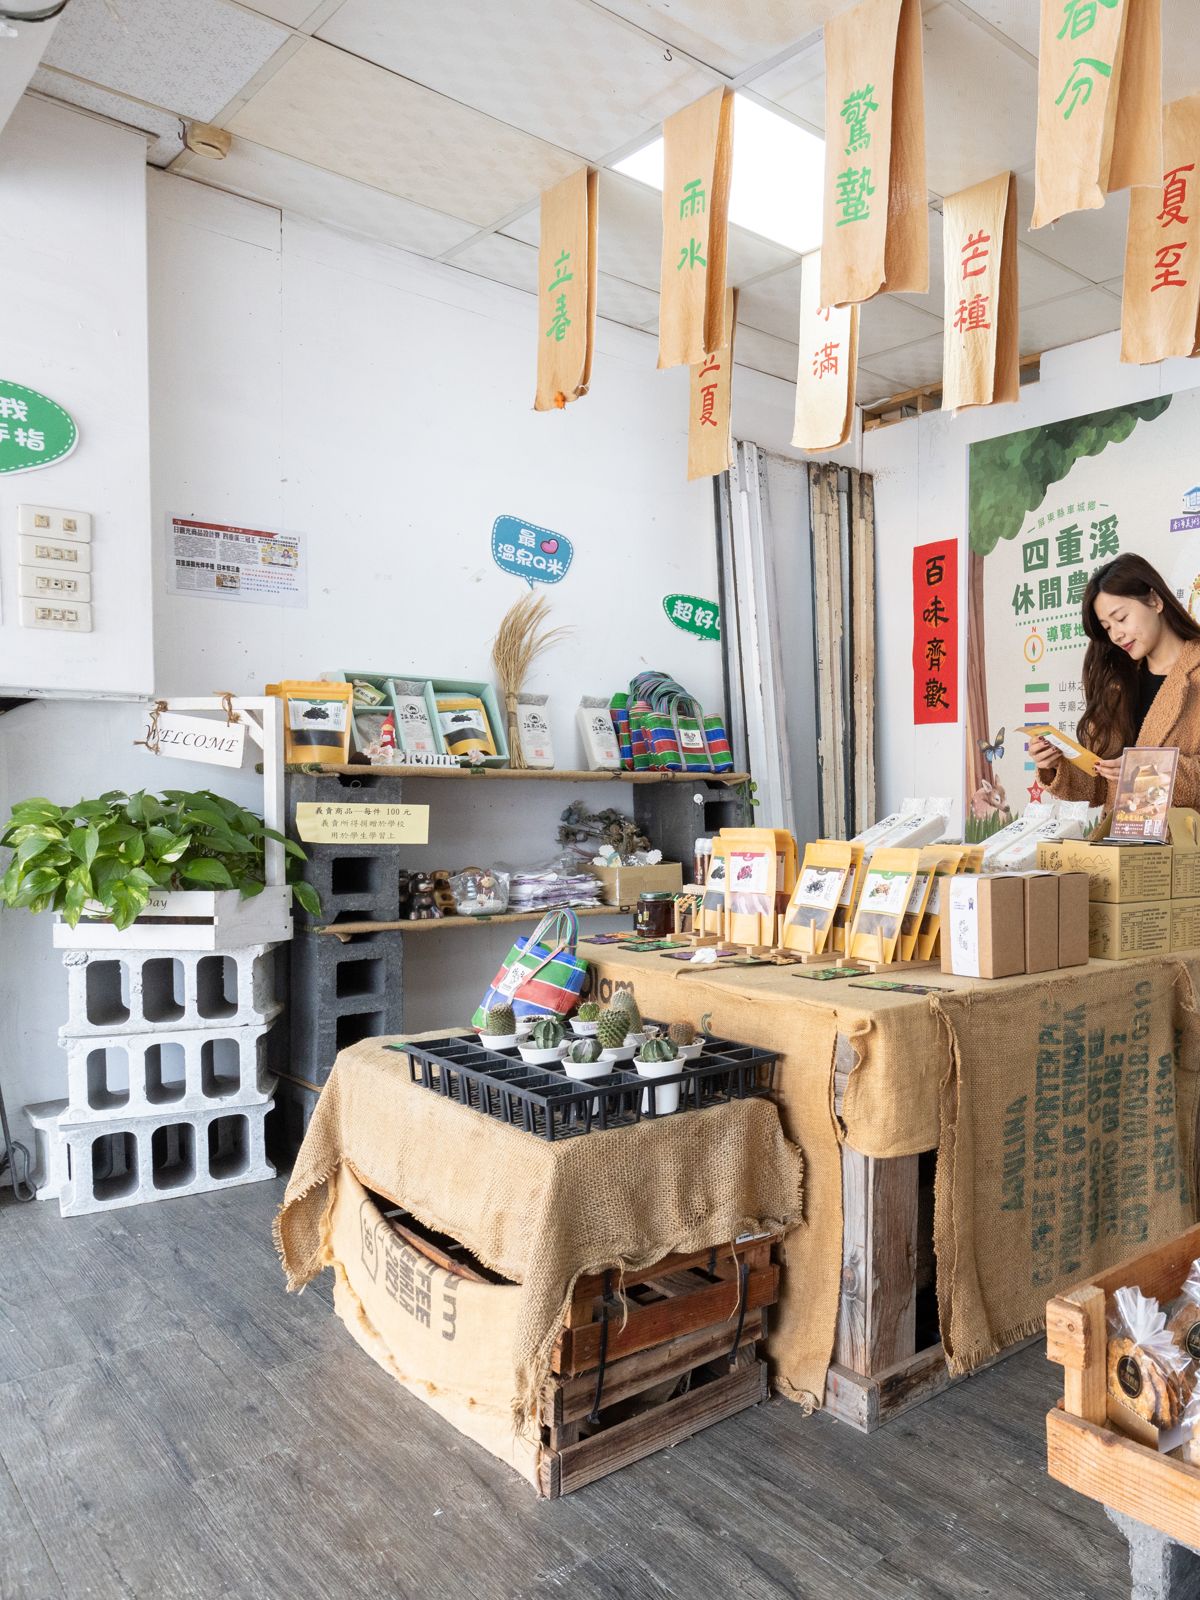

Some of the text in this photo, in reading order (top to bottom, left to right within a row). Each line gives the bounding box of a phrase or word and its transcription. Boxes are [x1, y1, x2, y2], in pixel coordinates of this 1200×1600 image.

[836, 83, 879, 228] 驚蟄
[677, 178, 707, 271] 雨水
[1151, 162, 1195, 293] 夏至
[546, 249, 574, 342] 立春
[953, 228, 992, 334] 芒種
[497, 543, 564, 575] 溫泉Q米
[518, 528, 536, 549] 最
[1022, 514, 1120, 574] 四重溪
[1012, 566, 1105, 617] 休閒農
[923, 555, 950, 710] 百味齊歡
[145, 724, 239, 753] WELCOME
[386, 807, 402, 816] 100
[1110, 1033, 1126, 1046] 2
[1034, 1048, 1060, 1179] EXPORTER
[1103, 1053, 1123, 1132] GRADE
[1063, 1123, 1085, 1154] OF
